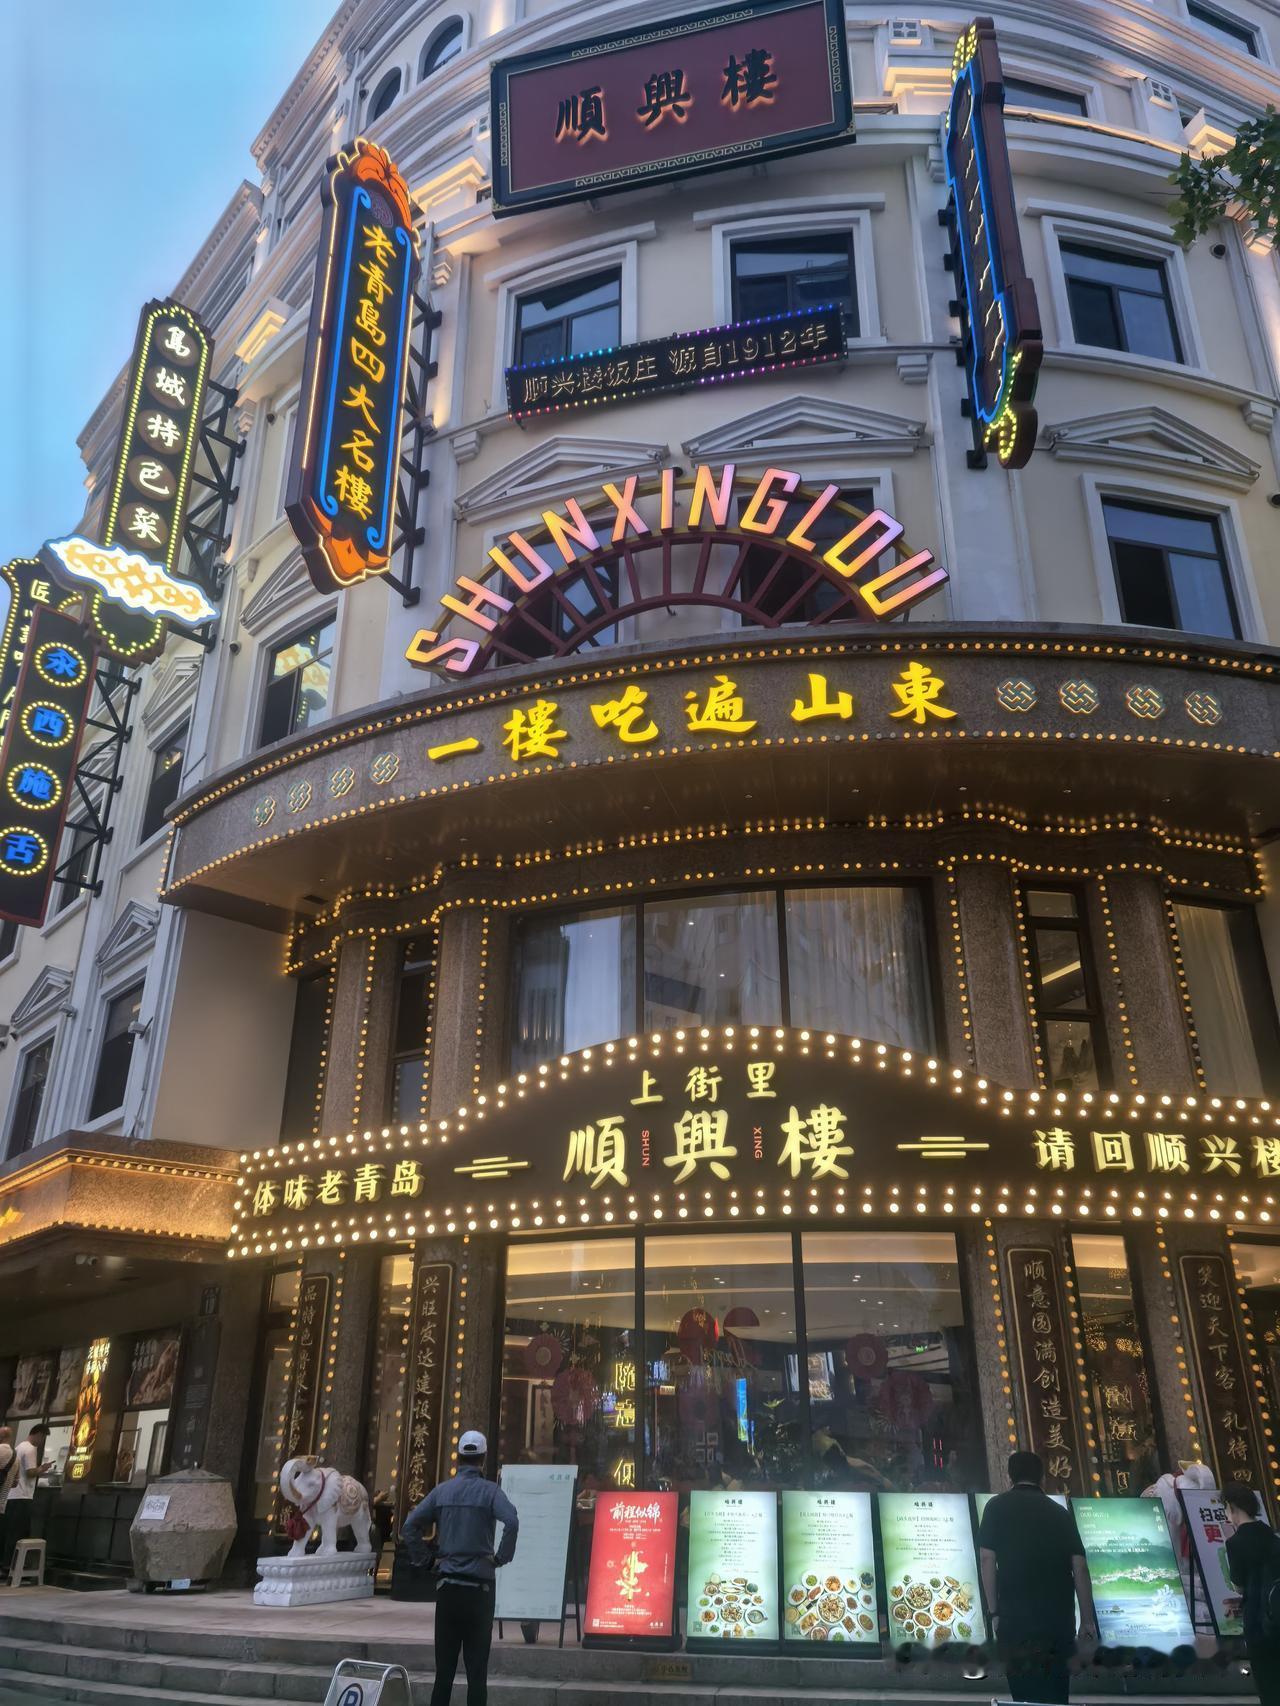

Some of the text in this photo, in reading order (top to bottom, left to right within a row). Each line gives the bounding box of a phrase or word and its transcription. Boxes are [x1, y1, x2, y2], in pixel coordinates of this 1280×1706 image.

[555, 47, 780, 143] 順興樓
[630, 1062, 777, 1106] 上街里
[562, 1103, 855, 1190] 順興樓
[641, 1129, 650, 1167] SHUN
[753, 1126, 763, 1160] XING
[252, 1160, 425, 1218] 体味老青岛
[407, 1275, 441, 1507] 兴旺发达建设繁荣家
